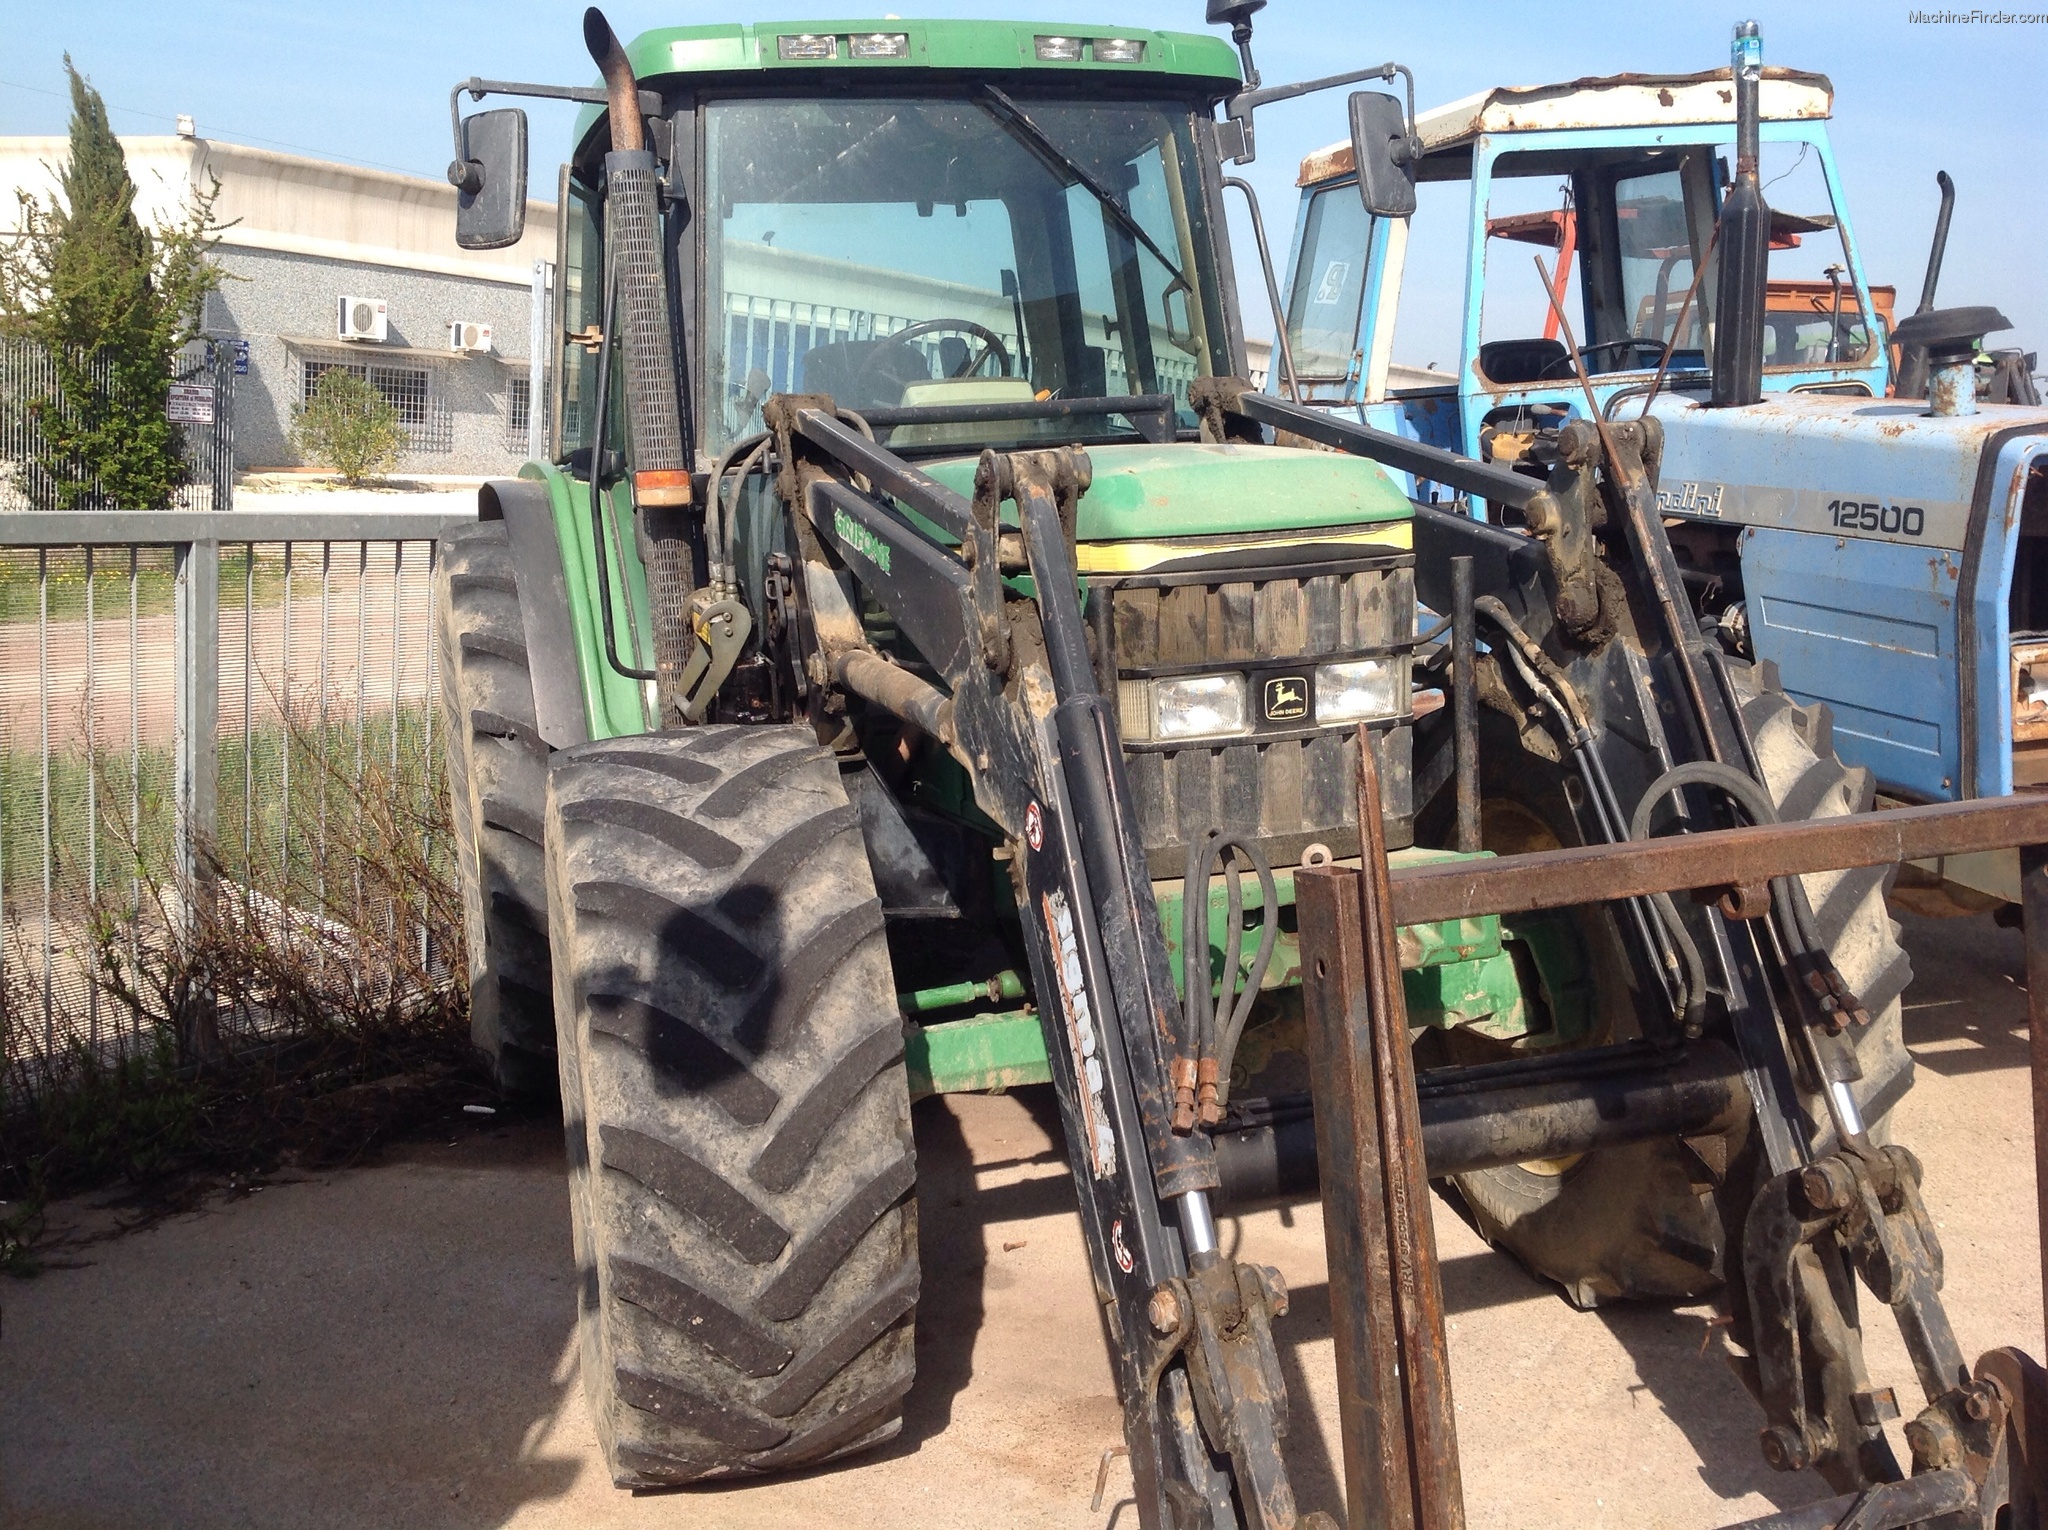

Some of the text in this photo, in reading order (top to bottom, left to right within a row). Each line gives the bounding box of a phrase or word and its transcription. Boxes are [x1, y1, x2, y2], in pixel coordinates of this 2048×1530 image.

[1656, 482, 1724, 518] ndini
[1827, 499, 1925, 537] 12500
[1285, 707, 1303, 715] DEERE
